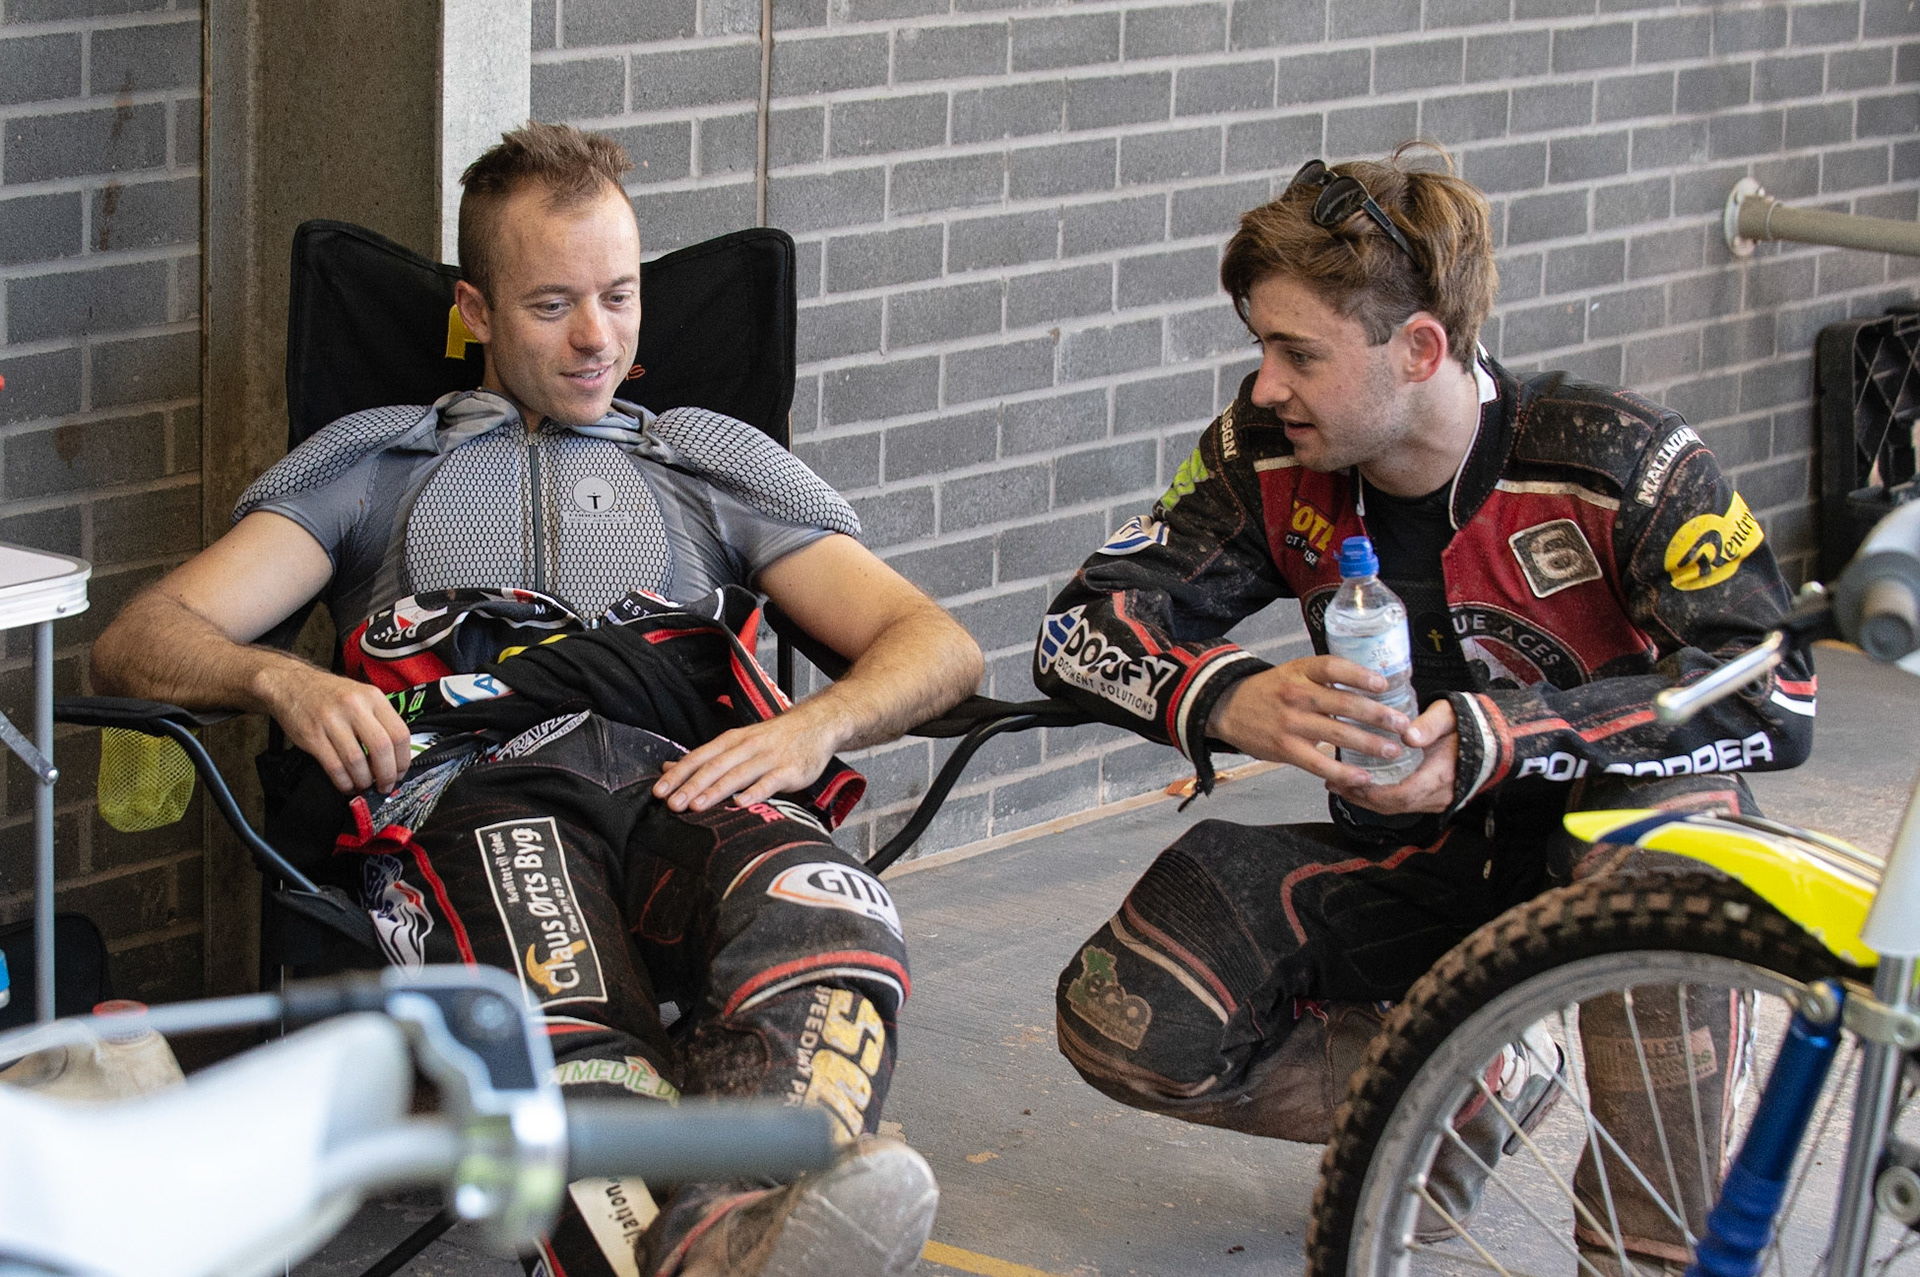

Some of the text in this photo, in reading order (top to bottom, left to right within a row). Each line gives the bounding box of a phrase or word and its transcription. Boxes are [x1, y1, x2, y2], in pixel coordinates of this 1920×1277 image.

[1530, 529, 1582, 579] 6
[1452, 613, 1561, 667] UE ACES
[1100, 682, 1154, 716] SOLUTIONS
[511, 827, 581, 989] Claus Ørts Byg
